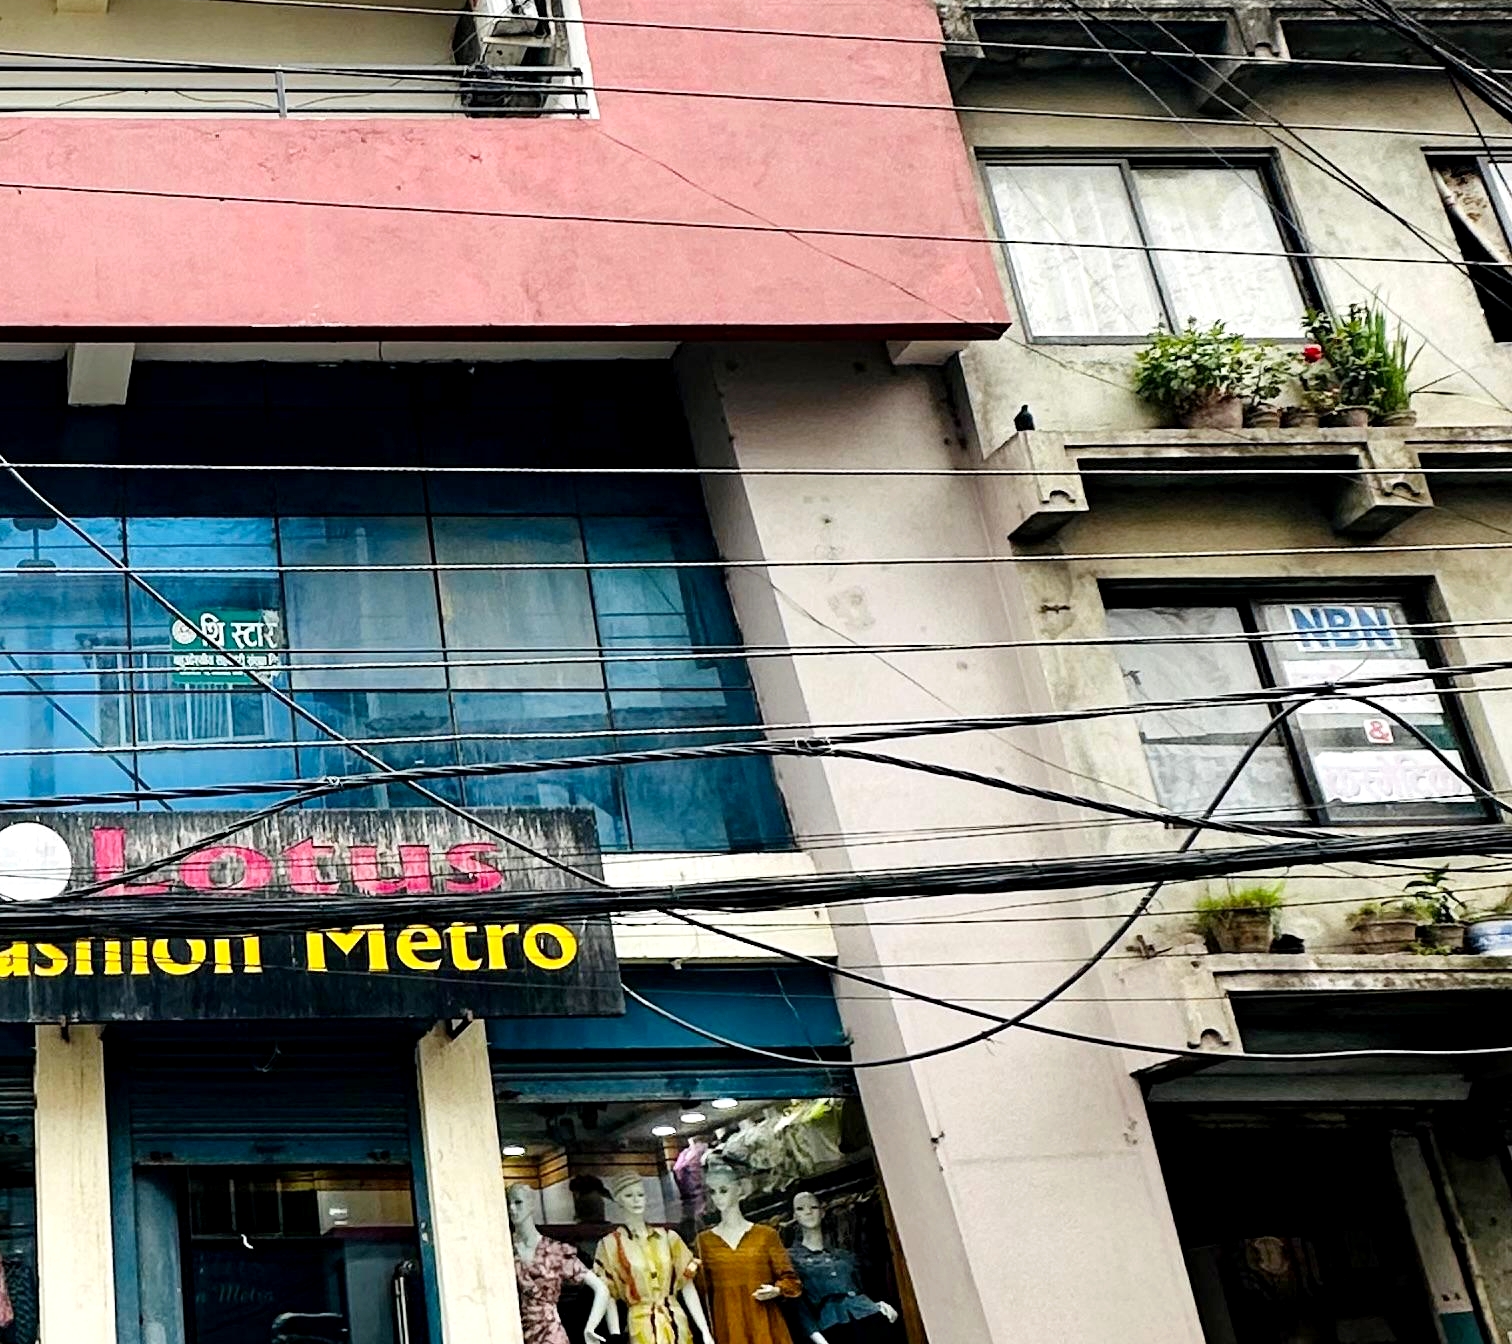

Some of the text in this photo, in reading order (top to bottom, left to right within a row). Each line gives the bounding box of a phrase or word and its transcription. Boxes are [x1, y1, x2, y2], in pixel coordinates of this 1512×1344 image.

[1292, 608, 1395, 647] NBN
[93, 826, 505, 897] Lotus
[306, 921, 579, 973] Metro
